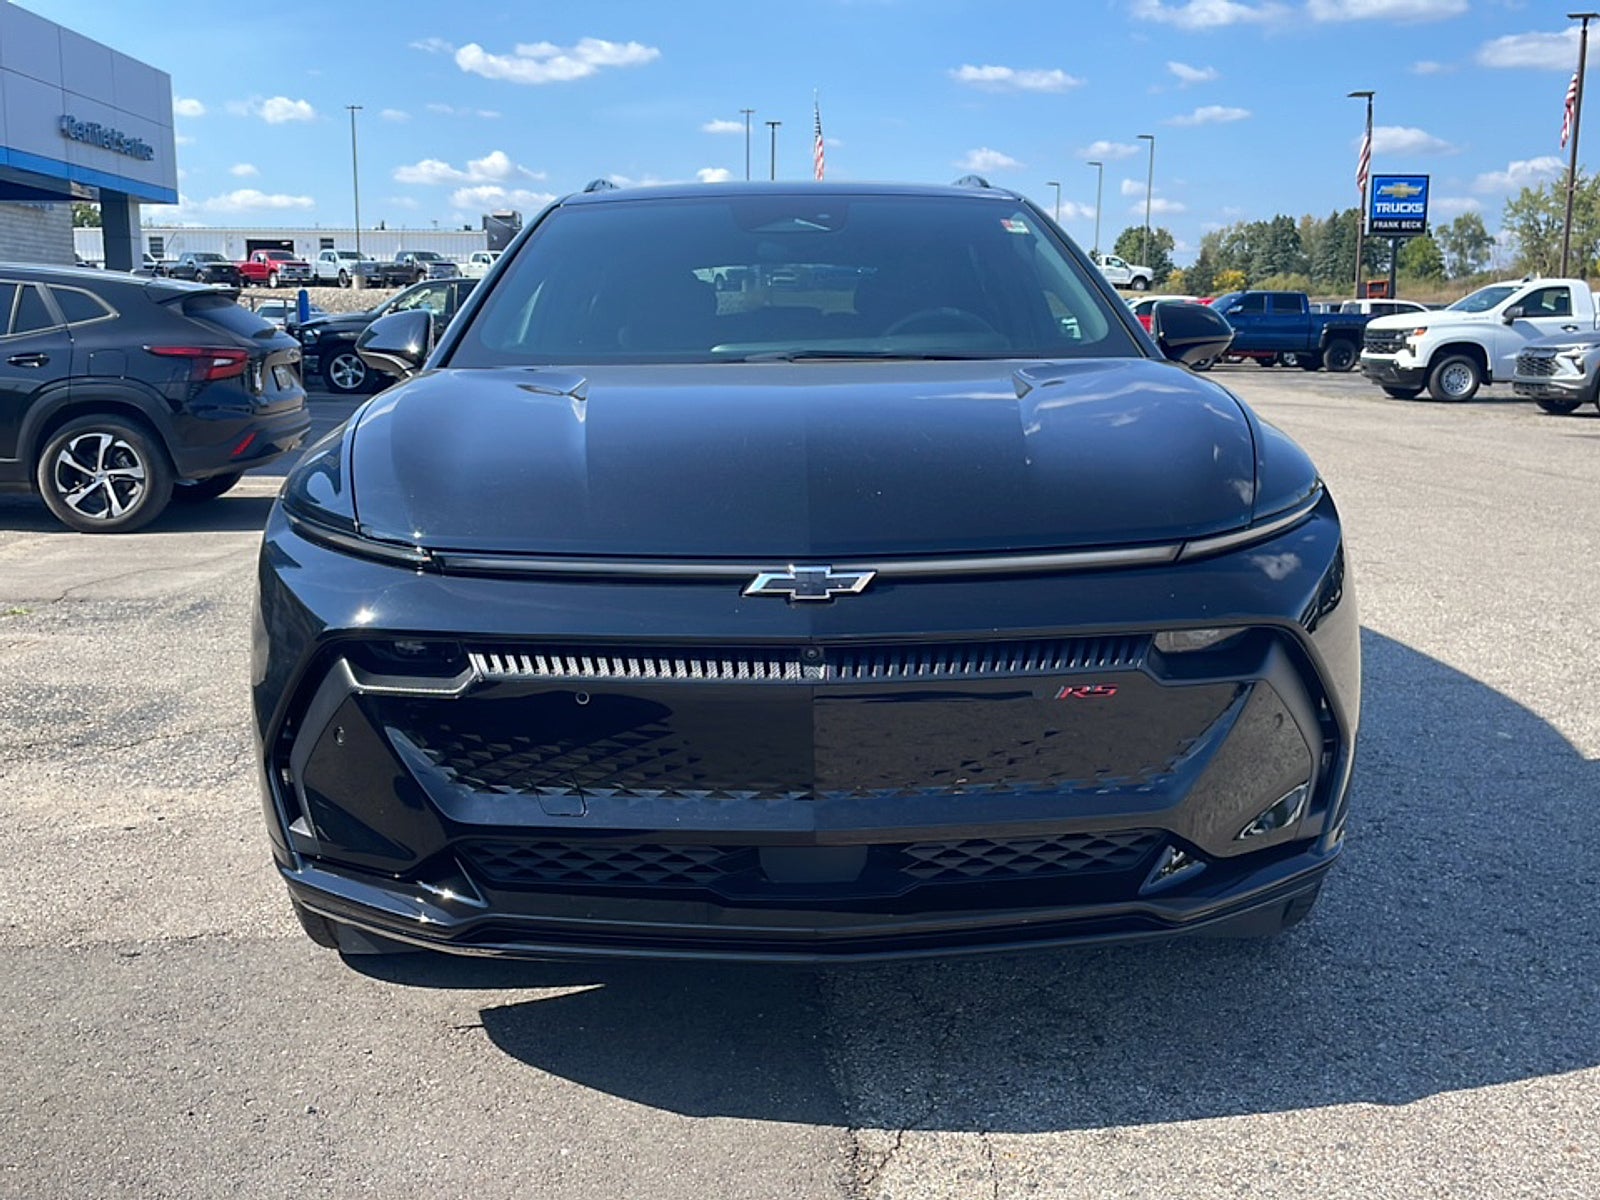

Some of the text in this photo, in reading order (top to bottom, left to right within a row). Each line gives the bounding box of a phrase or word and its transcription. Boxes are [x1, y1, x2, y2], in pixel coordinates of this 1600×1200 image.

[58, 115, 154, 160] Certified Service
[1375, 202, 1424, 213] TRUCKS
[1373, 221, 1422, 229] FRANK BECK
[1057, 683, 1117, 698] RS
